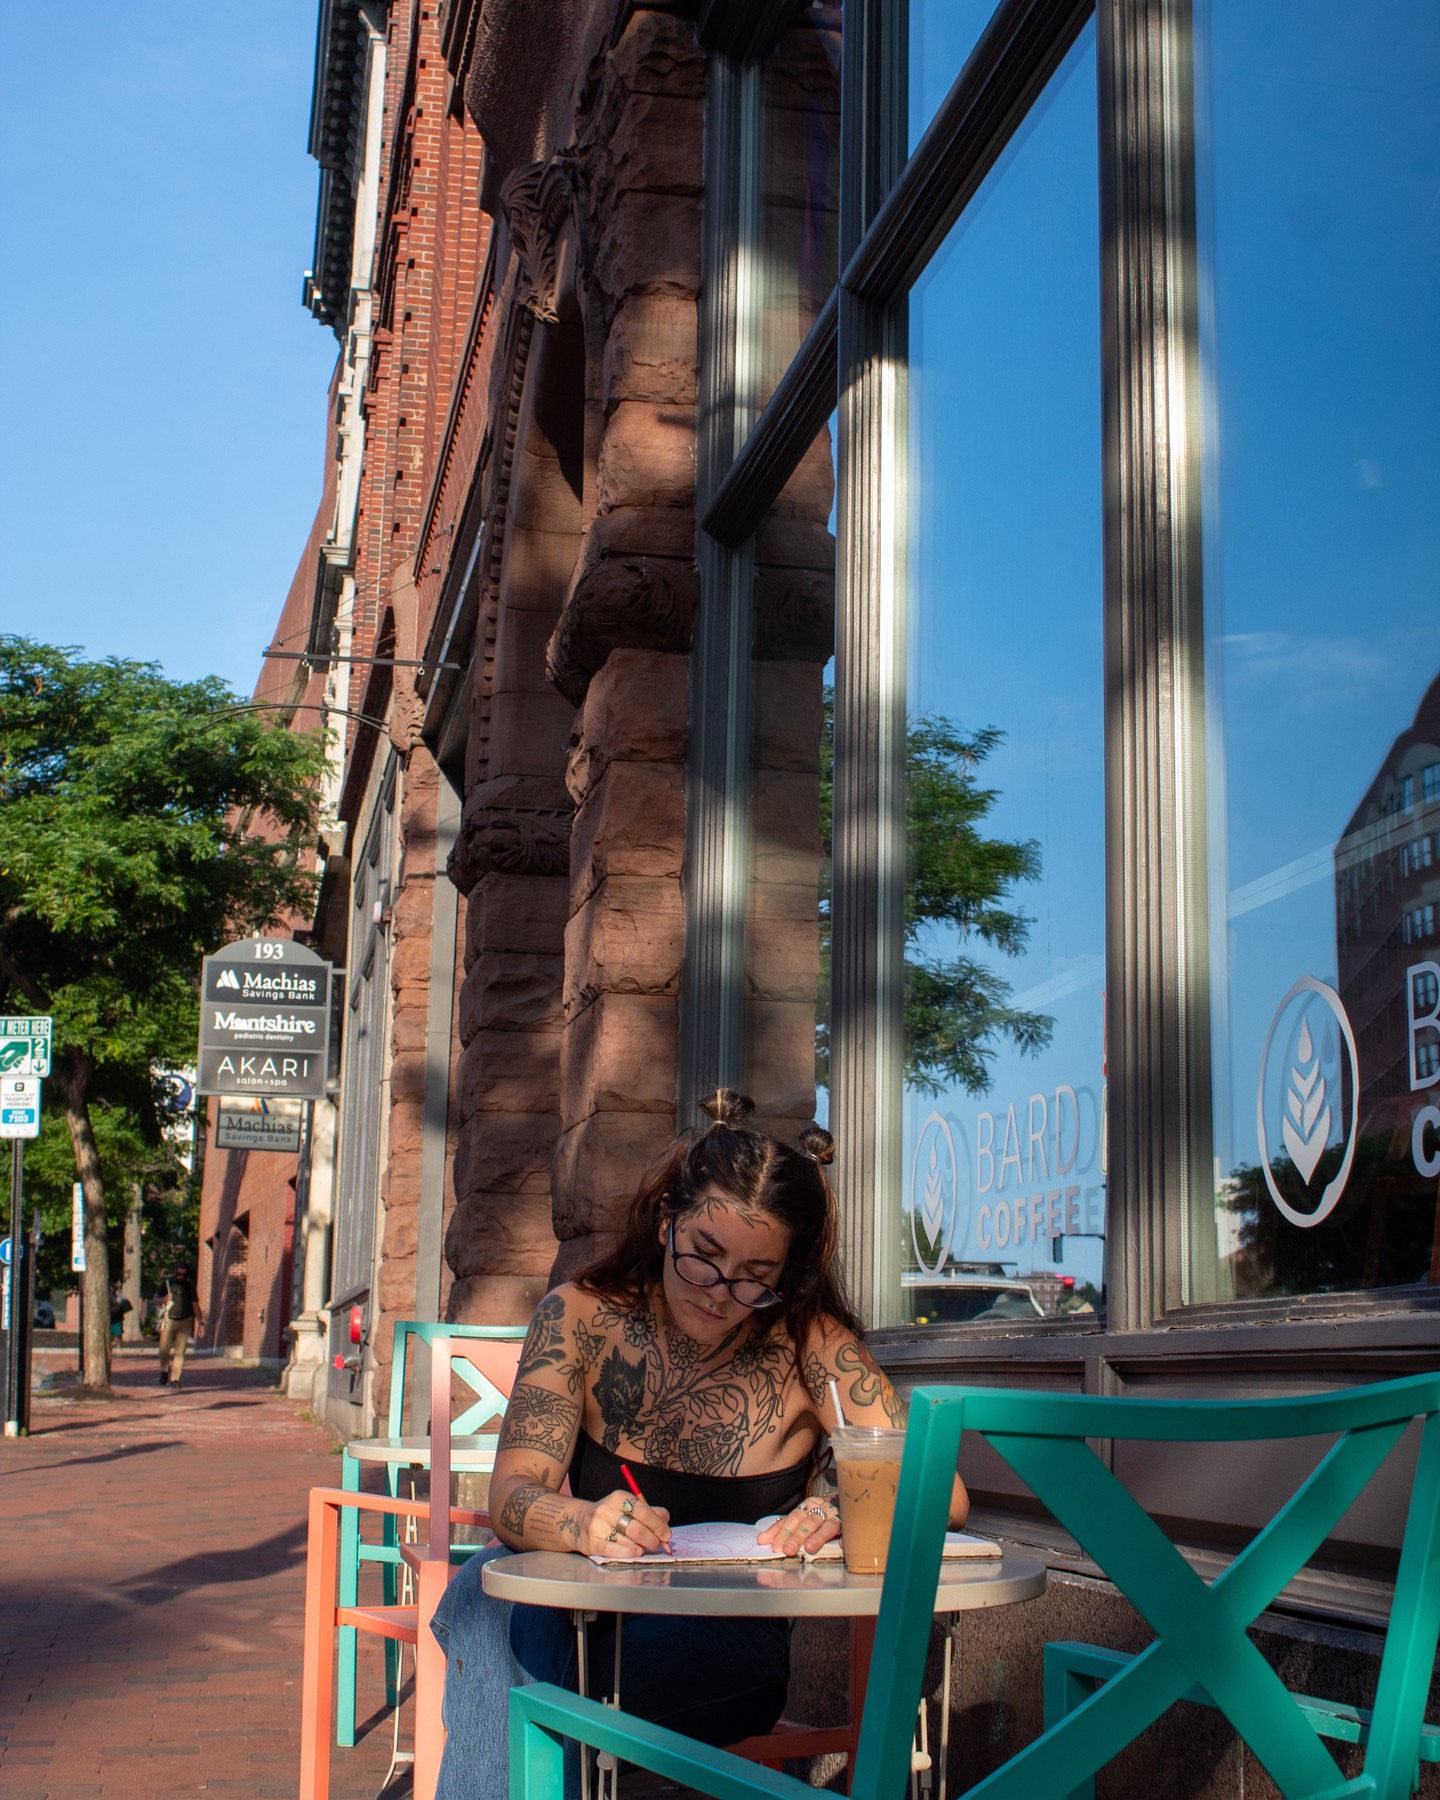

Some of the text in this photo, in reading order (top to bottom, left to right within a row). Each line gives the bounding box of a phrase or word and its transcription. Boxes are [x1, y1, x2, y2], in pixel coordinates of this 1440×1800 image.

[253, 943, 284, 960] 193
[243, 971, 316, 992] Machias
[242, 989, 316, 1001] Savings Bank
[217, 1055, 308, 1078] AKARI
[236, 1077, 288, 1088] salon spa
[225, 1115, 293, 1134] Machias
[224, 1132, 292, 1144] Savings Bank
[977, 1084, 1079, 1194] BARD
[977, 1185, 1080, 1250] COFFEE
